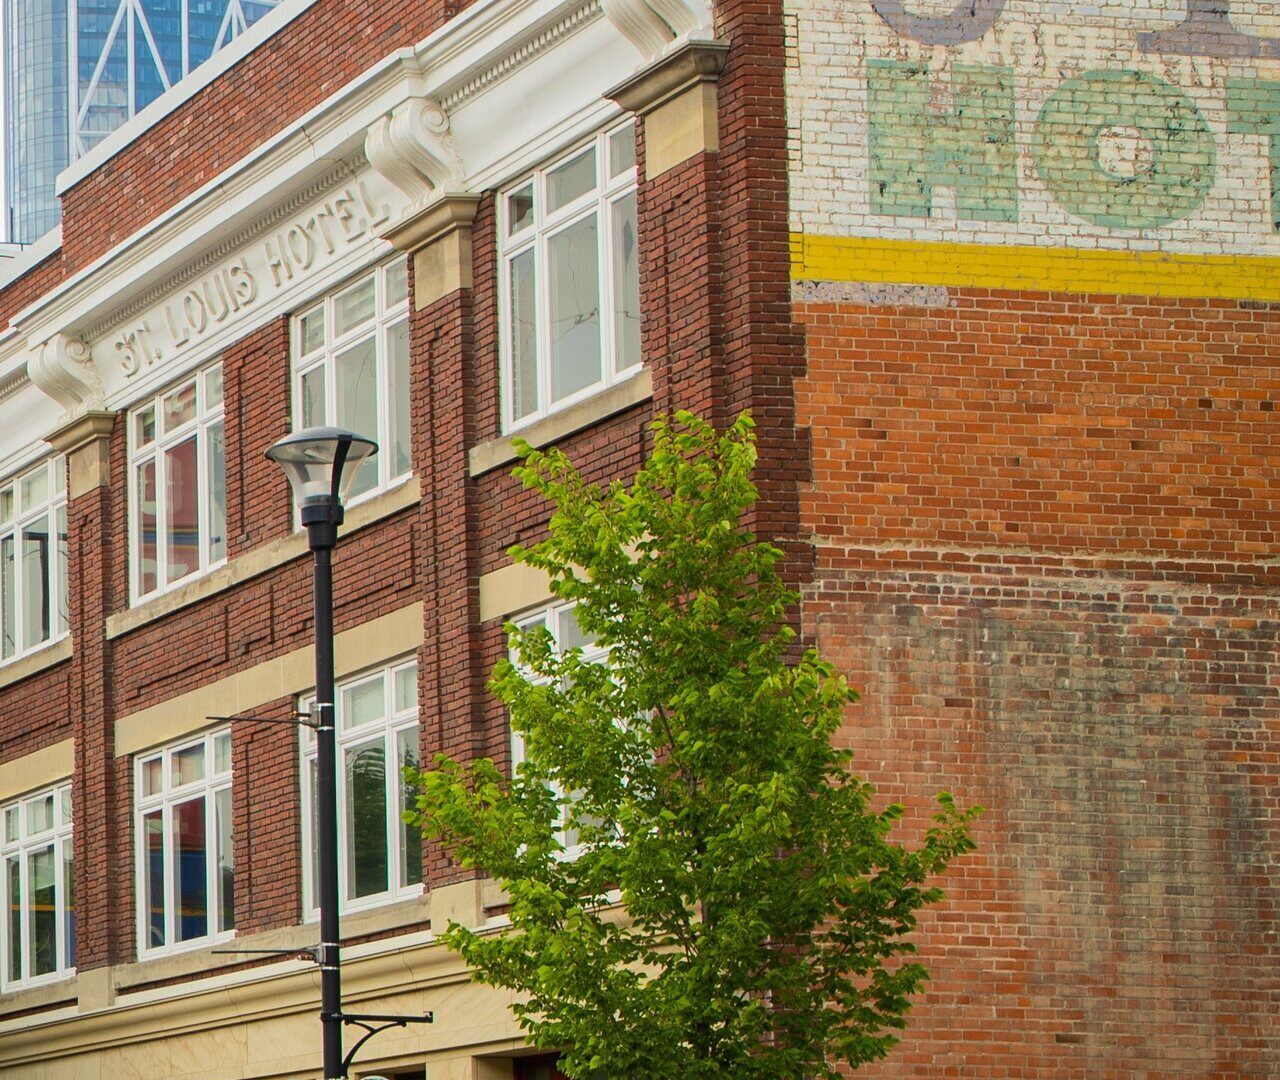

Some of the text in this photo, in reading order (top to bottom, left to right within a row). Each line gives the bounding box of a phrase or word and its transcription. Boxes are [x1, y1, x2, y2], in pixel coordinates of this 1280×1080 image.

[114, 181, 390, 379] ST. LOUIS HOTEL
